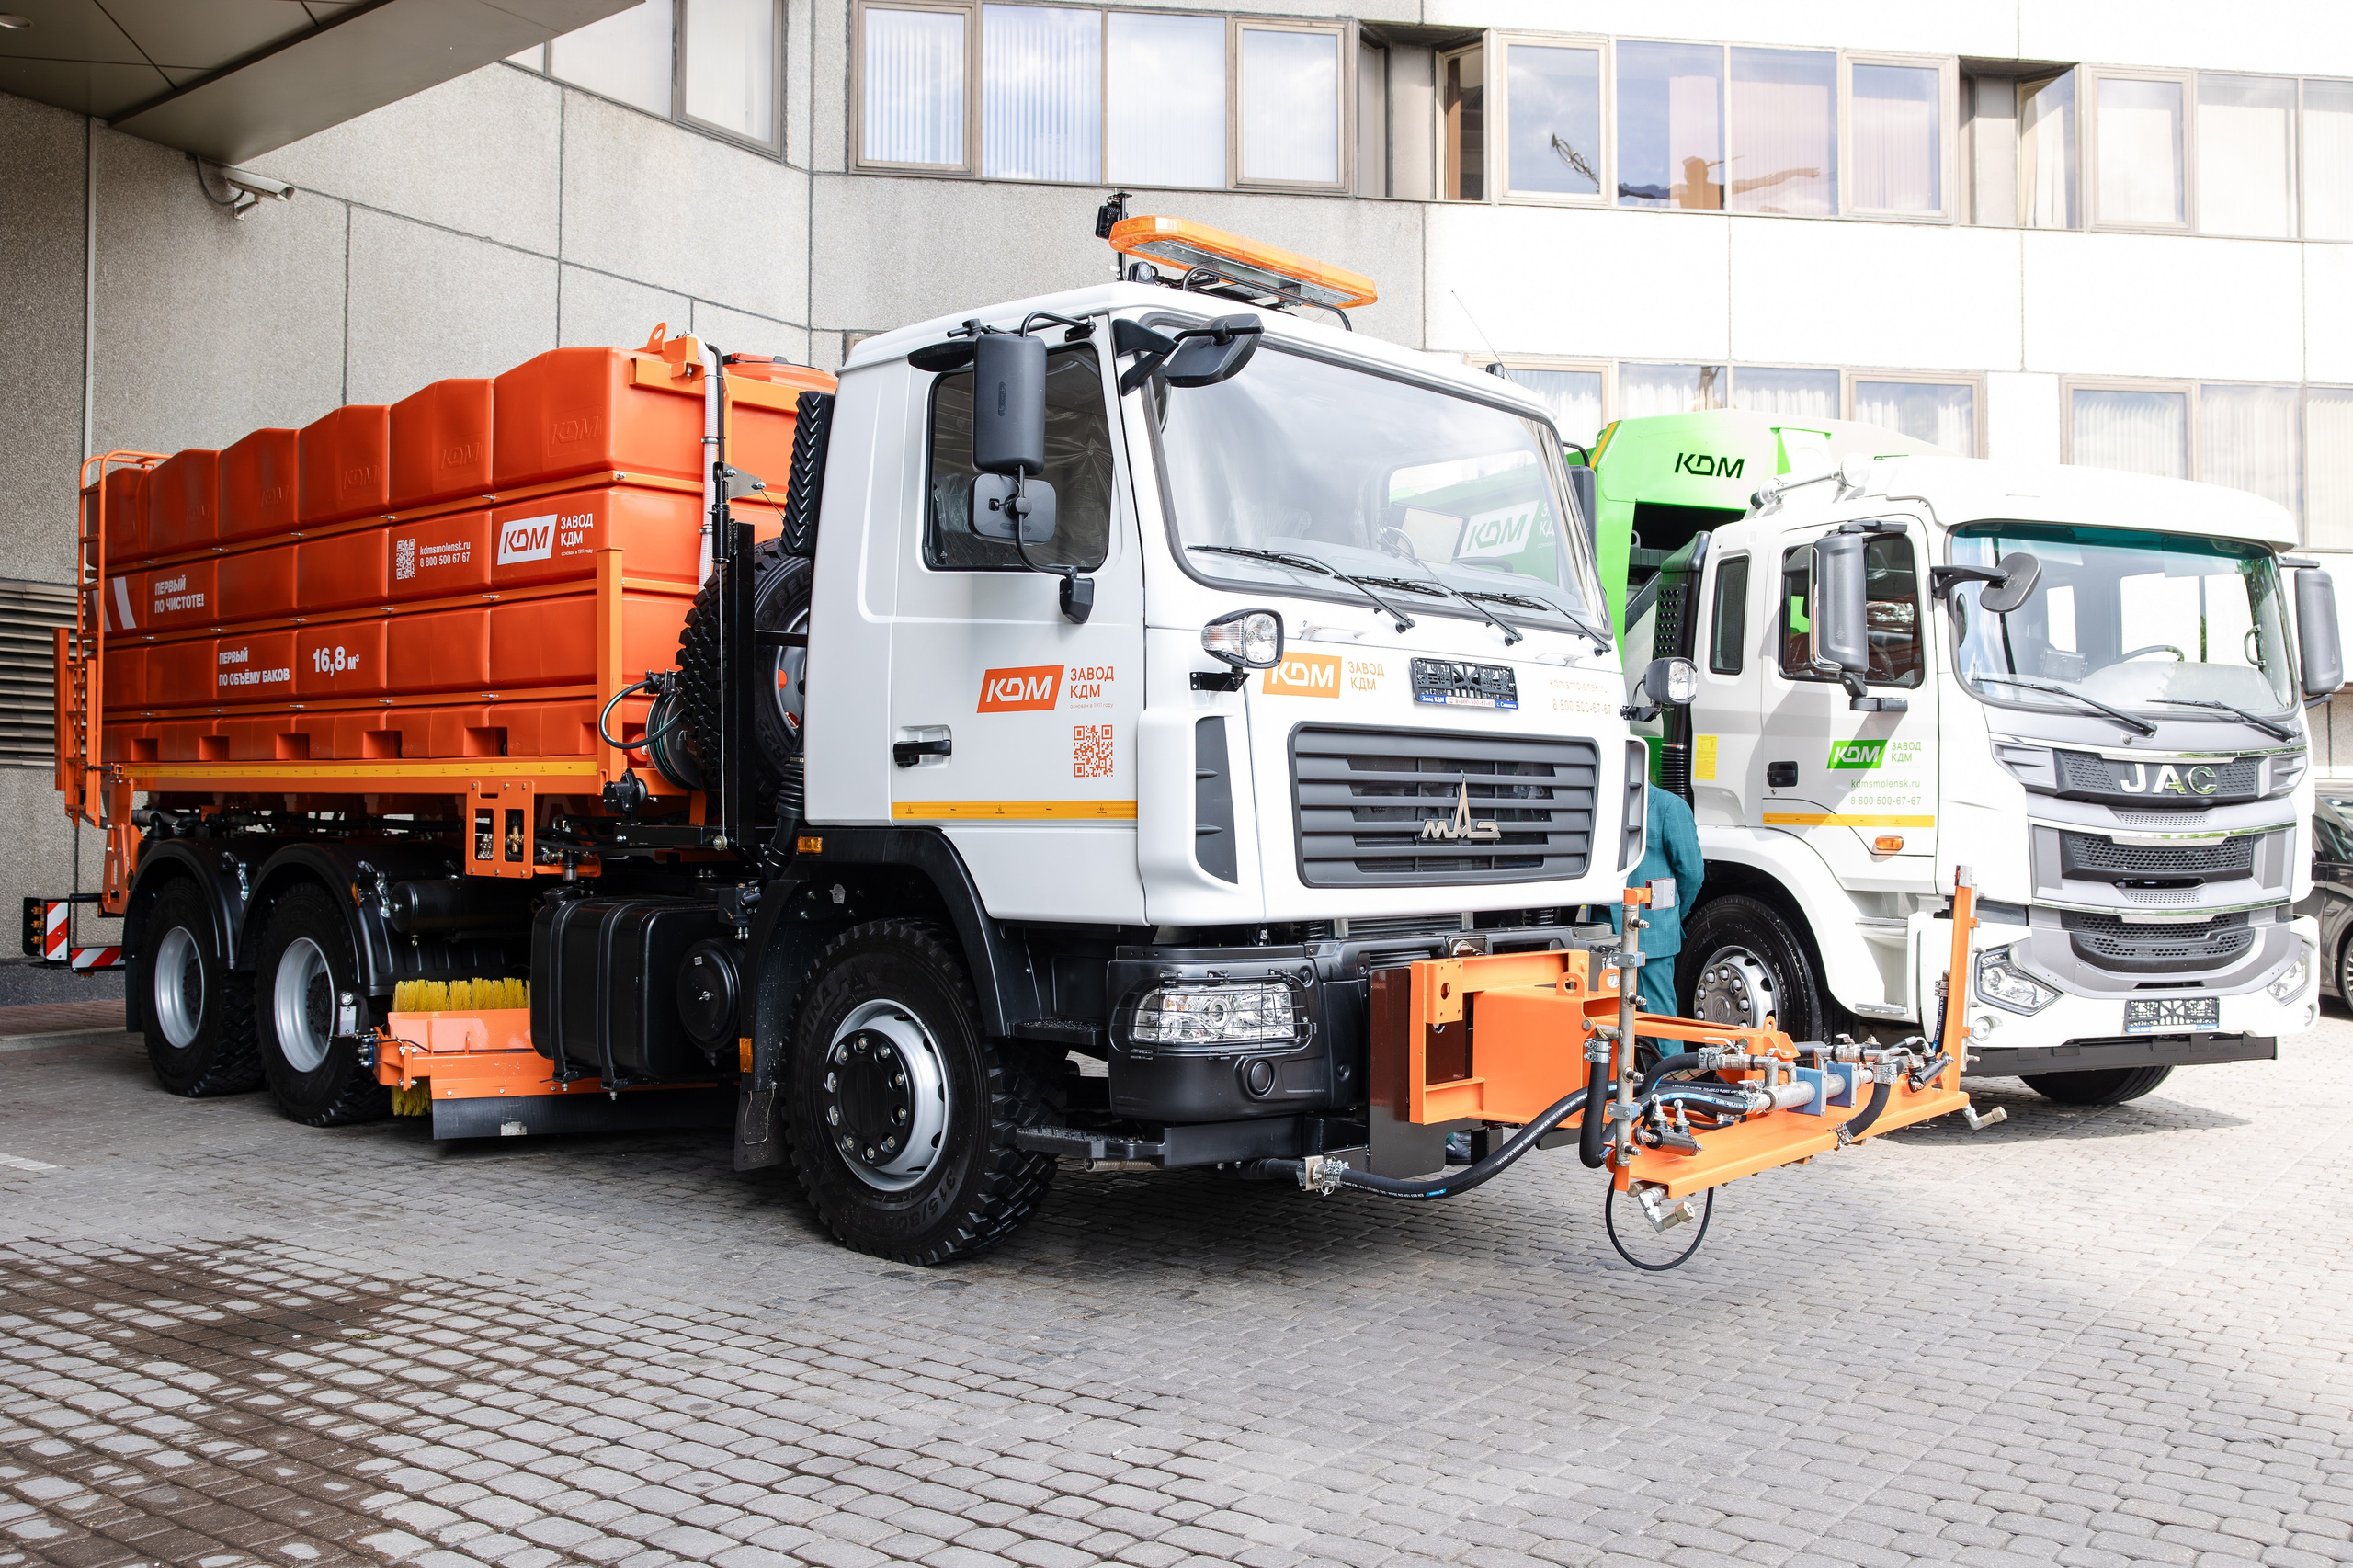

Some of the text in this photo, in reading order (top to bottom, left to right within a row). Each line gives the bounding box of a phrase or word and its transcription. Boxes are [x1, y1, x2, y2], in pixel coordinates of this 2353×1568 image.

[551, 415, 603, 446] KDM
[1674, 452, 1745, 479] KDM
[560, 513, 594, 531] ЗАВОД
[503, 525, 550, 554] KDM
[560, 530, 584, 548] КДМ
[1466, 513, 1529, 551] KDM
[420, 540, 471, 556] kdmsmolensk.ru
[419, 551, 471, 568] 8 800 500 67 67
[154, 574, 187, 597] ПЕРВЫЙ
[774, 573, 811, 609] BEL
[154, 593, 205, 614] ПО ЧИСТОТЕ!
[218, 647, 249, 665] ПЕРВЫЙ
[313, 645, 347, 676] 16,8
[218, 667, 290, 687] ПО ОБЪЁМУ БАКОВ
[1069, 665, 1115, 683] ЗАВОД
[1271, 661, 1335, 688] KDM
[1347, 661, 1385, 678] ЗАВОД
[985, 676, 1054, 703] KDM
[1069, 683, 1101, 699] КДМ
[1350, 676, 1377, 691] КДМ
[1833, 745, 1881, 763] KDM
[1892, 741, 1922, 752] ЗАВОД
[1891, 752, 1913, 763] КДМ
[1850, 778, 1921, 788] kdmsmolensk.ru
[2119, 763, 2218, 795] JAC
[1850, 796, 1922, 805] 8 800 500-67-67
